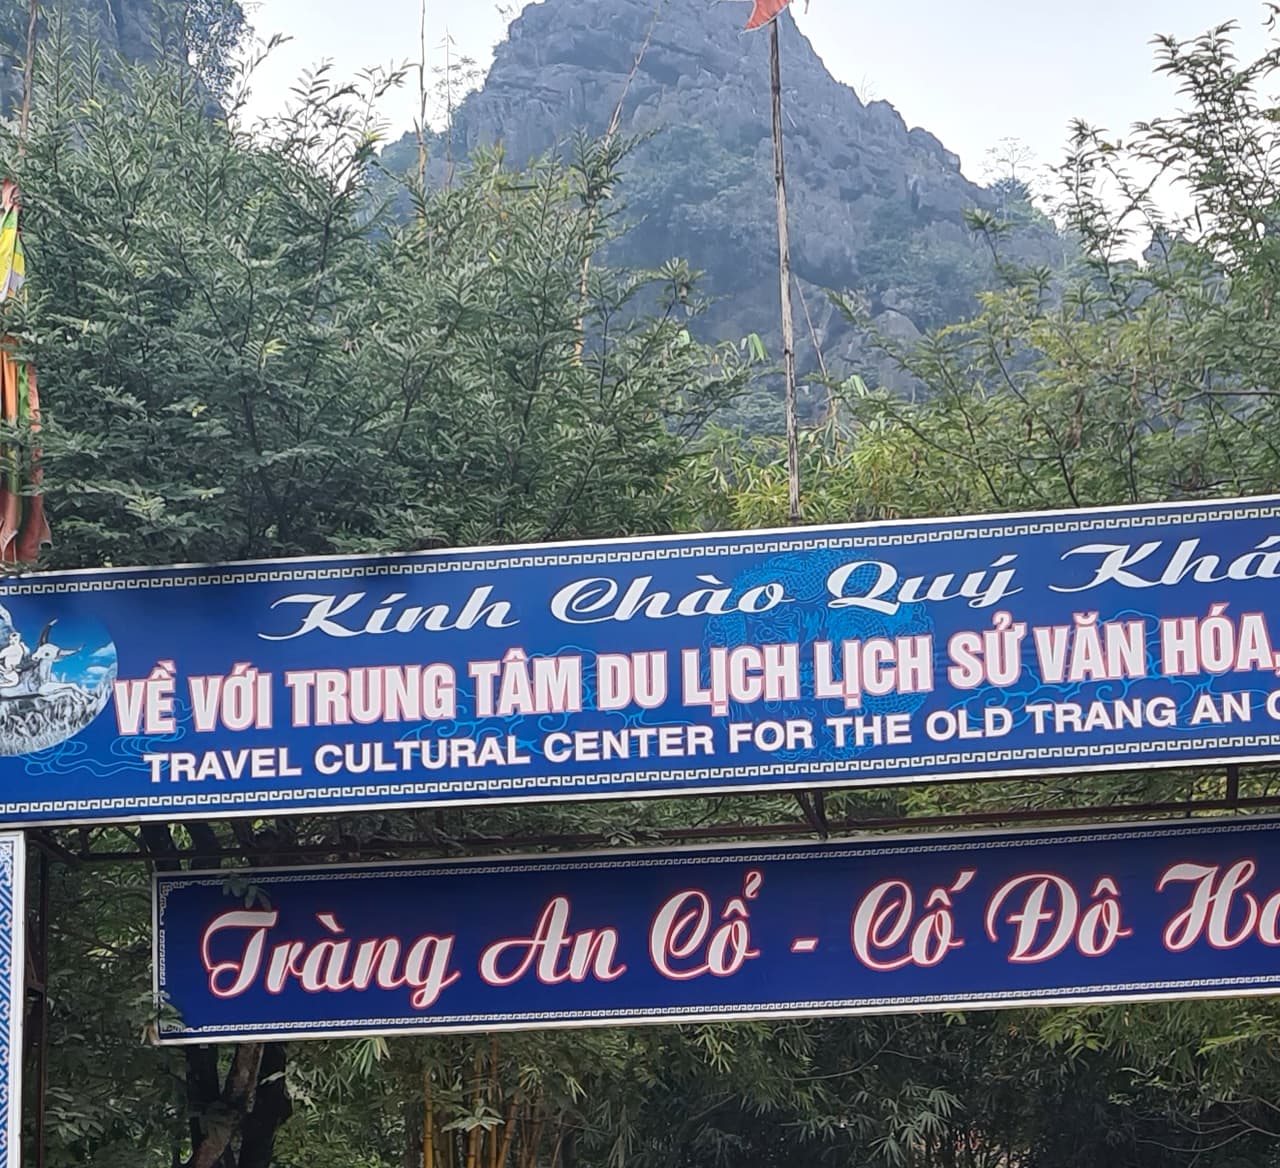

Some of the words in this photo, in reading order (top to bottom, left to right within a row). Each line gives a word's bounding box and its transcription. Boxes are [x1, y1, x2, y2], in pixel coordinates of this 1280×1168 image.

[257, 585, 520, 642] Kính
[550, 573, 796, 625] Chào
[826, 552, 1023, 616] Quý
[114, 659, 177, 736] VỀ
[188, 661, 273, 733] VỚI
[285, 662, 457, 728] TRUNG
[468, 647, 583, 718] TÂM
[596, 650, 668, 713] DU
[681, 641, 800, 717] LỊCH
[814, 635, 935, 710] LỊCH
[947, 611, 1028, 691] SỬ
[1033, 611, 1148, 684] VĂN
[142, 747, 302, 783] TRAVEL
[314, 734, 532, 776] CULTURAL
[543, 724, 715, 763] CENTER
[729, 718, 815, 753] FOR
[827, 712, 913, 748] THE
[926, 707, 1013, 742] OLD
[1026, 696, 1177, 735] TRANG
[1191, 691, 1251, 725] AN
[201, 909, 460, 1009] Tràng
[479, 896, 627, 985] An
[649, 870, 765, 981] Cổ
[790, 936, 818, 954] -
[850, 870, 976, 971] Cố
[985, 871, 1133, 963] Đô
